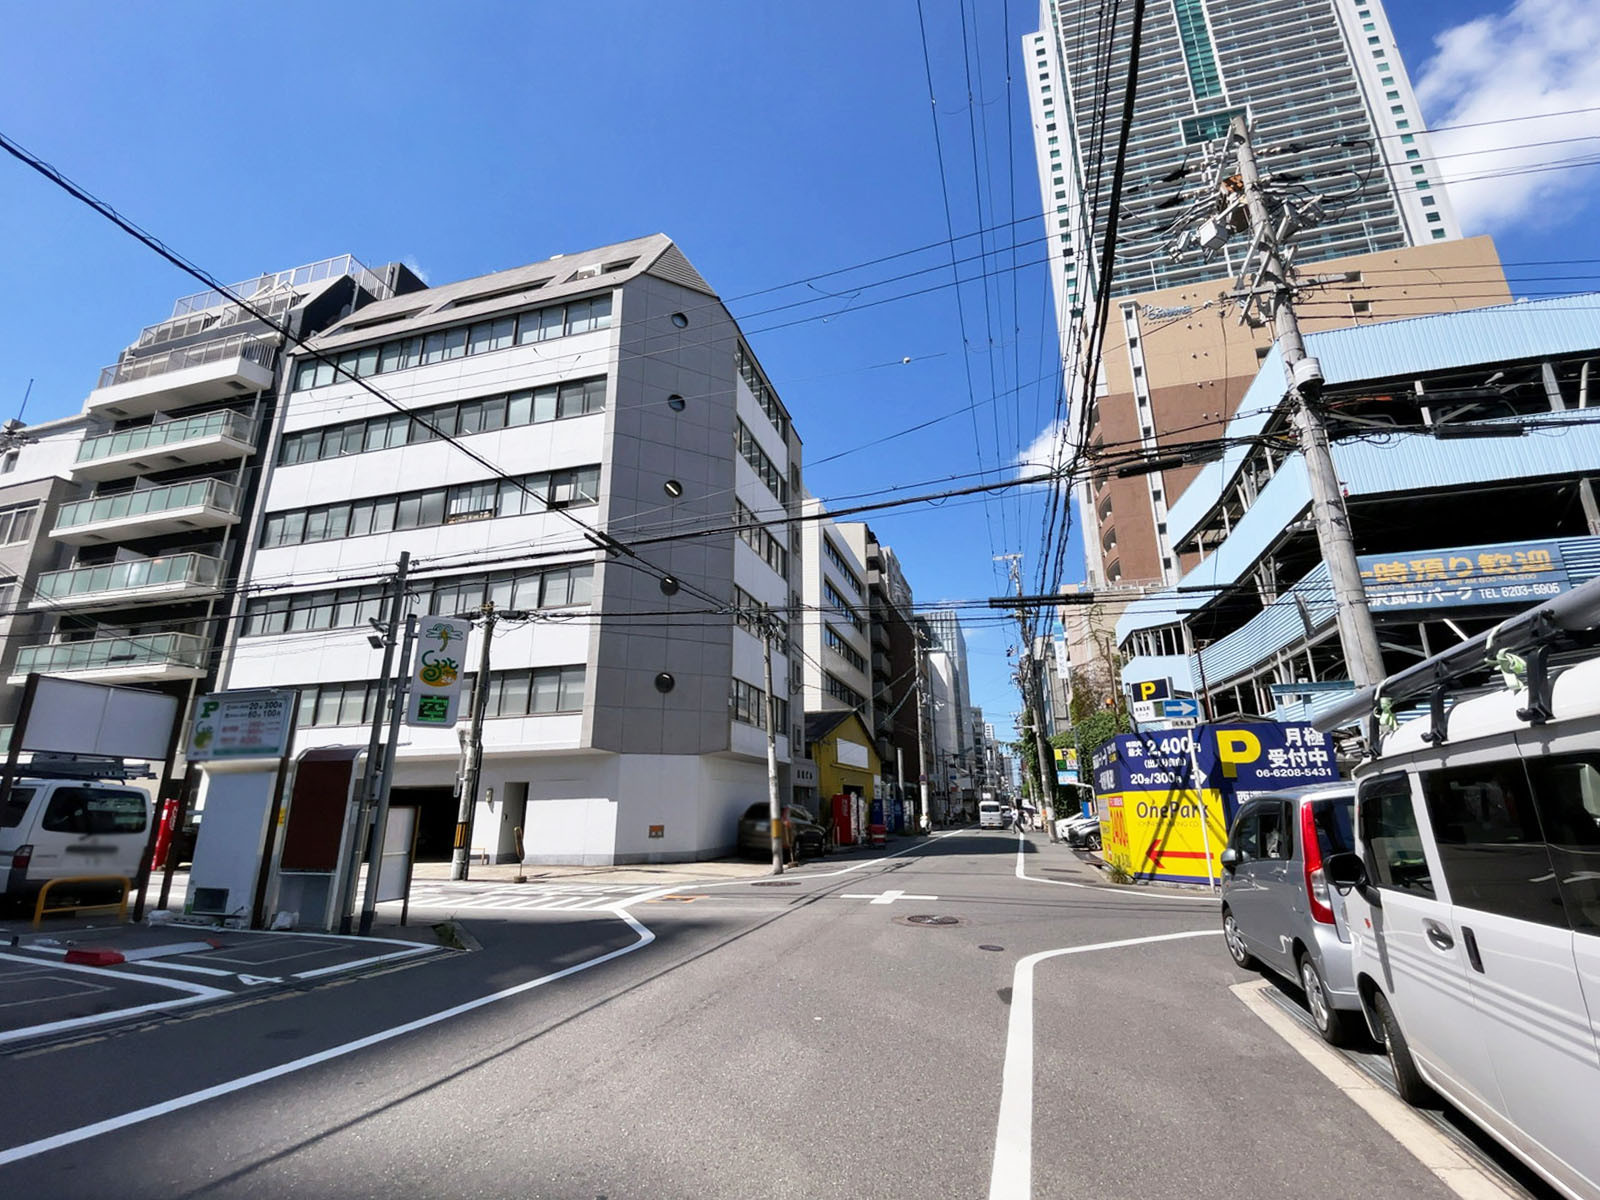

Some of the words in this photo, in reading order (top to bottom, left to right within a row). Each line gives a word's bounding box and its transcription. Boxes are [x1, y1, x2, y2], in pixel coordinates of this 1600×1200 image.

[1479, 588, 1500, 599] TEL
[1140, 681, 1156, 701] P
[200, 701, 220, 718] P
[1285, 727, 1325, 746] 月極
[1215, 729, 1262, 778] P
[1267, 747, 1329, 768] 受付中
[1256, 767, 1332, 778] 06-6208-5431
